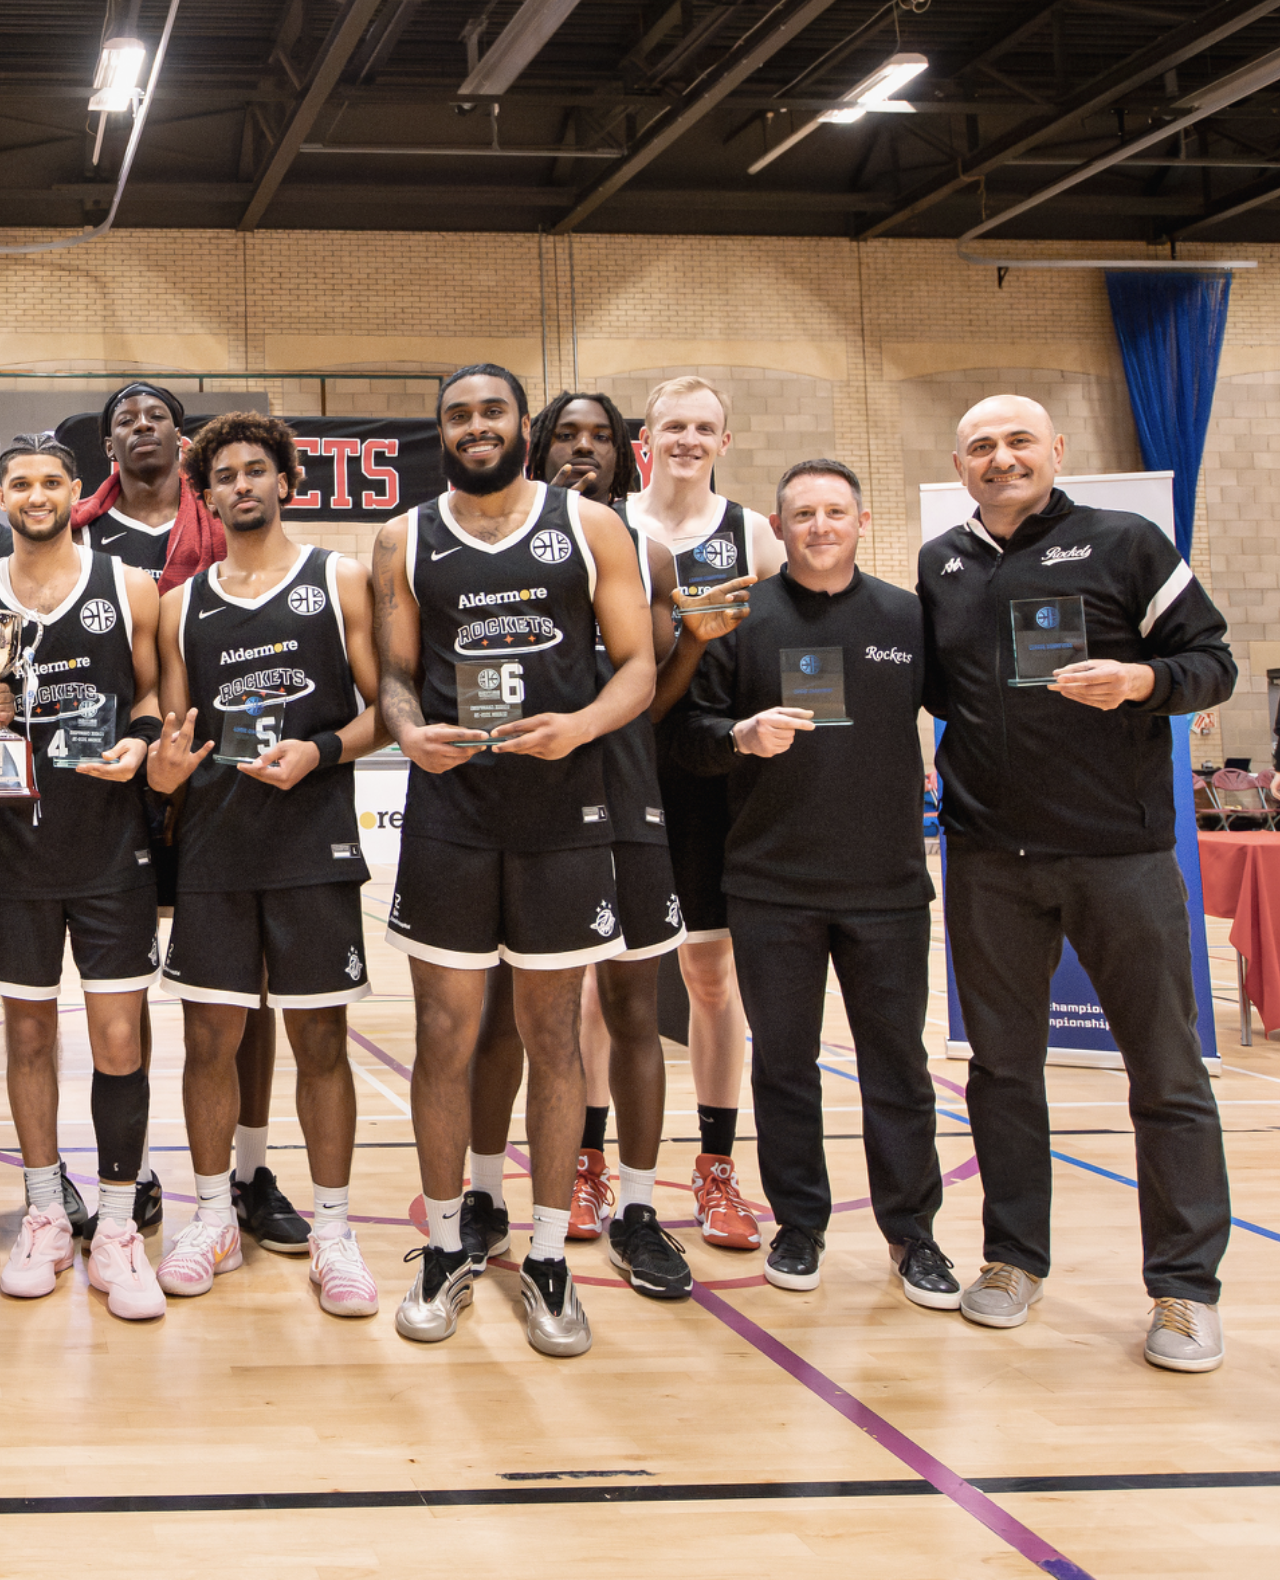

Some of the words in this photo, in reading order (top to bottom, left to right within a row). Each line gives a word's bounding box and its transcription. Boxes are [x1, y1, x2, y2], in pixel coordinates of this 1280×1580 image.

[1041, 544, 1093, 561] Rockets
[458, 587, 548, 609] Aldermore
[457, 616, 554, 645] ROCKETS
[220, 640, 298, 665] Aldermore
[864, 646, 913, 664] Rockets
[14, 682, 98, 713] RCKETS
[219, 667, 306, 702] ROCKETS
[500, 663, 525, 704] 6
[47, 728, 68, 757] 4
[255, 716, 277, 757] 5
